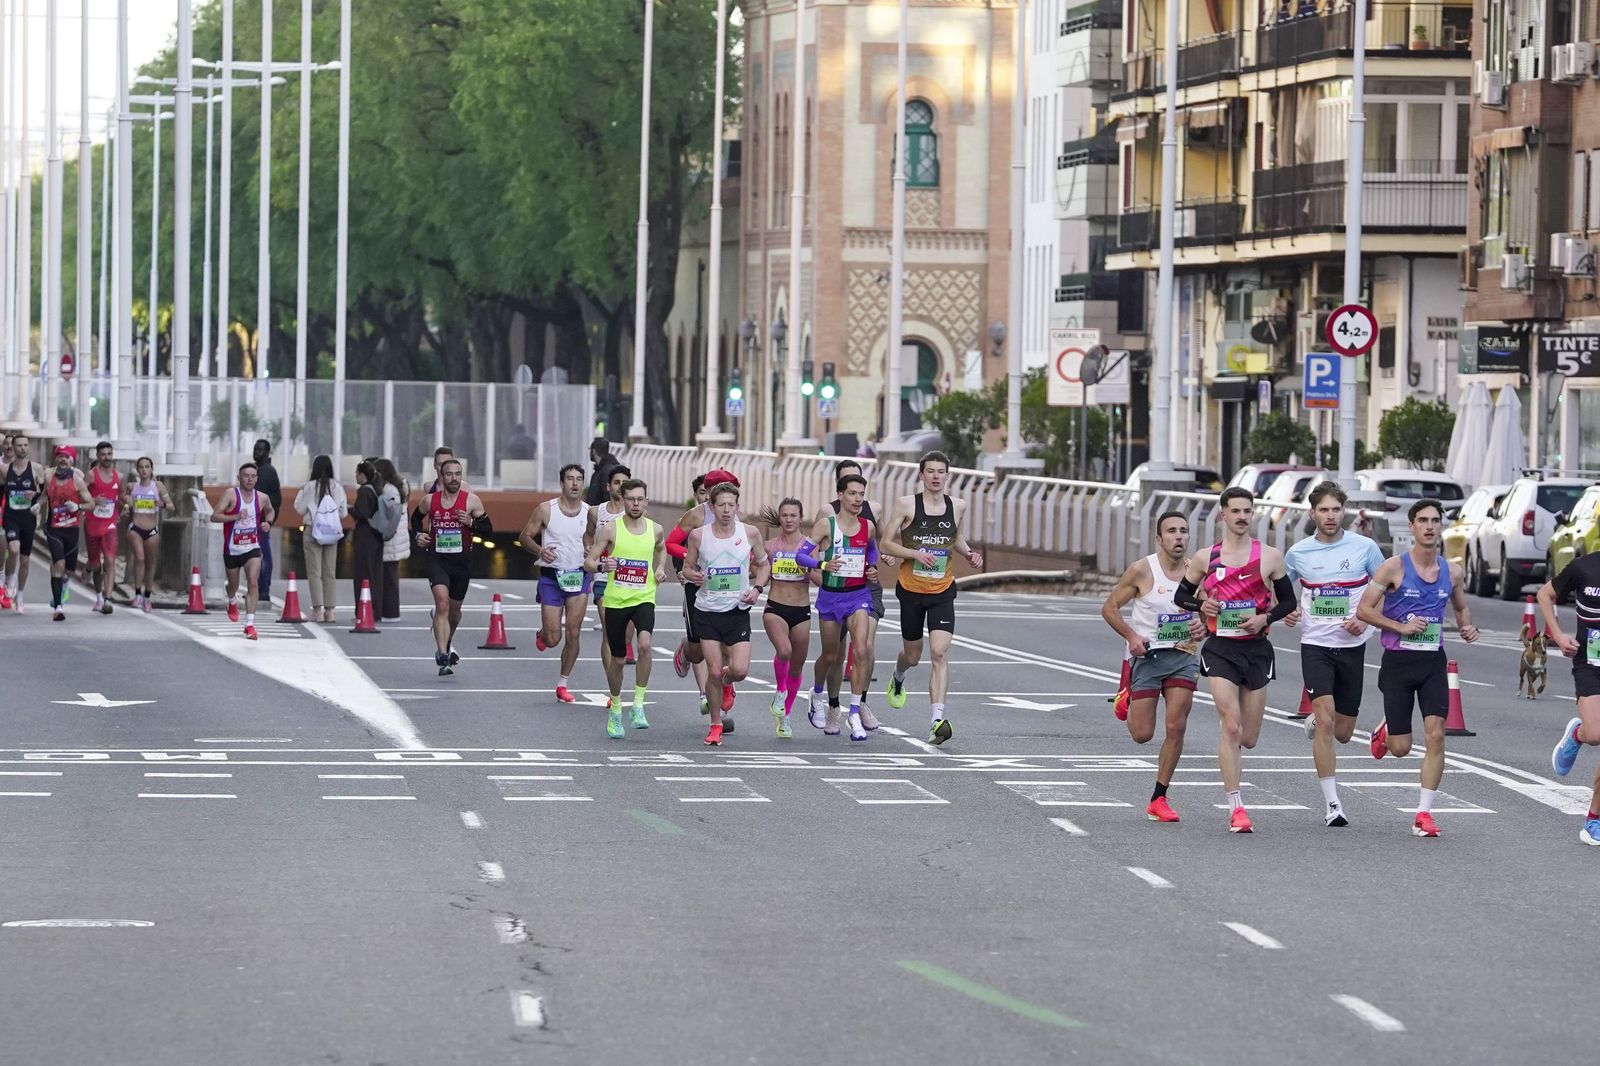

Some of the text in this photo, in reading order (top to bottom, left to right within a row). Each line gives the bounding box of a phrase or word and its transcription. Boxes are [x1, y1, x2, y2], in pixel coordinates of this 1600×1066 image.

[1541, 336, 1599, 351] TINTE
[1556, 351, 1592, 376] 5€
[1309, 358, 1332, 387] P
[1171, 613, 1191, 621] ZURICH
[1315, 607, 1345, 615] TERRIER
[1407, 633, 1435, 642] MATHIS
